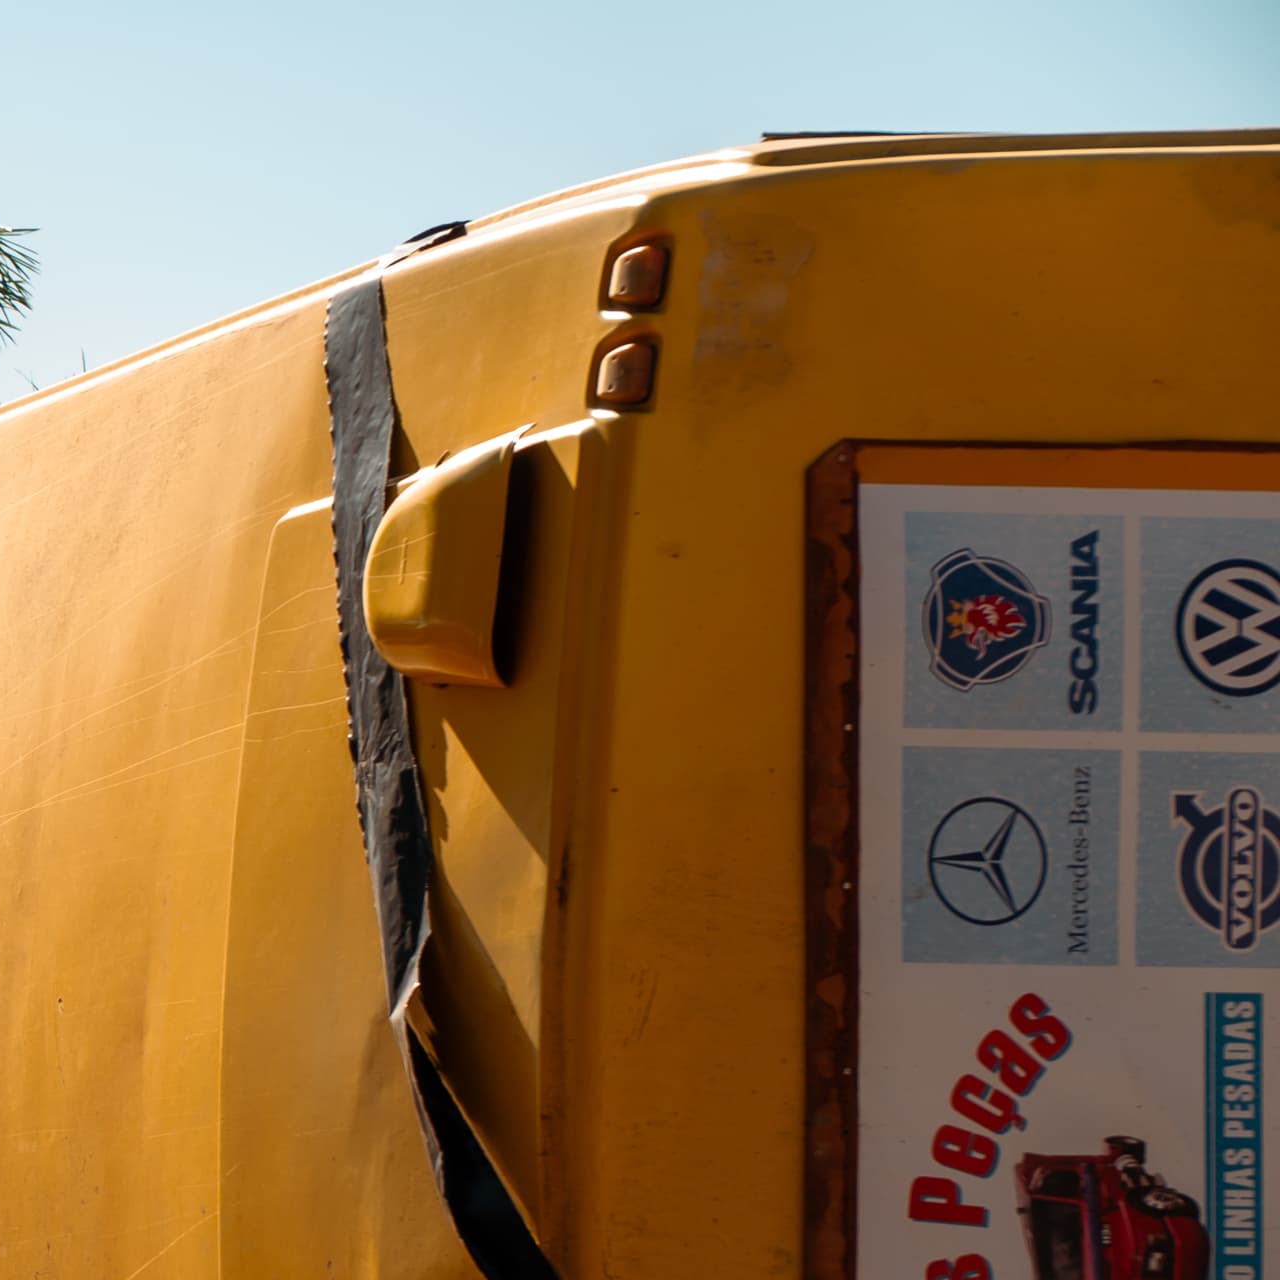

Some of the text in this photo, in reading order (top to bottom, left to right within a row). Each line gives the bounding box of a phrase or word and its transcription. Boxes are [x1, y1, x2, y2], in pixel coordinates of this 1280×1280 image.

[1067, 529, 1100, 716] SCANIA
[1066, 765, 1091, 955] Mercedes-Benz
[1230, 790, 1256, 945] VOLVO
[908, 992, 1071, 1228] Peças
[1223, 1000, 1257, 1139] PESADAS
[1223, 1148, 1256, 1256] LINHAS
